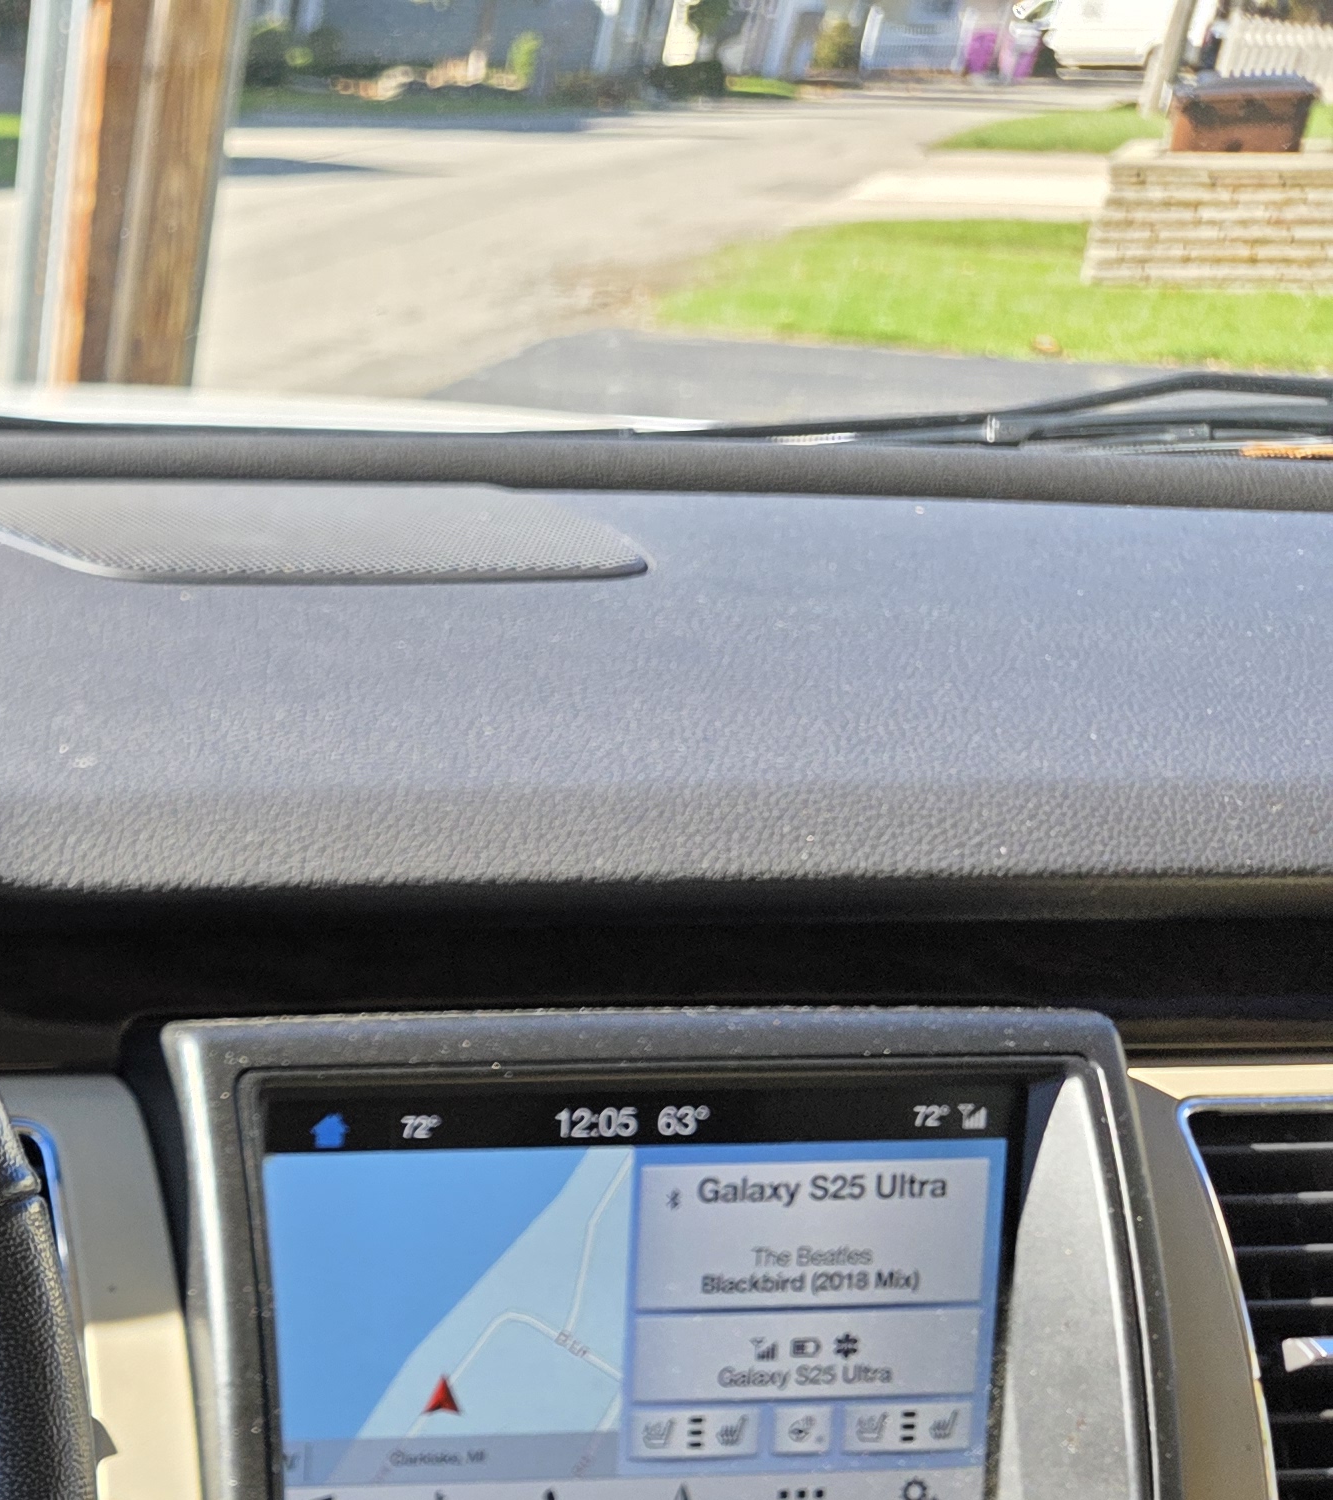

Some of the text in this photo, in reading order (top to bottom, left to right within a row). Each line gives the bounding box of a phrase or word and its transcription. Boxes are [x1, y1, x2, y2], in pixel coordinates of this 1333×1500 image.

[400, 1114, 443, 1139] 72°
[555, 1106, 639, 1138] 12:05
[657, 1104, 711, 1136] 63°
[913, 1103, 951, 1128] 72°
[697, 1172, 948, 1207] Galaxy S25 Ultra
[751, 1245, 874, 1267] The Beatles
[701, 1268, 921, 1296] Blackbird (2018 Mix)
[717, 1364, 893, 1390] Galaxy S25 Ultra
